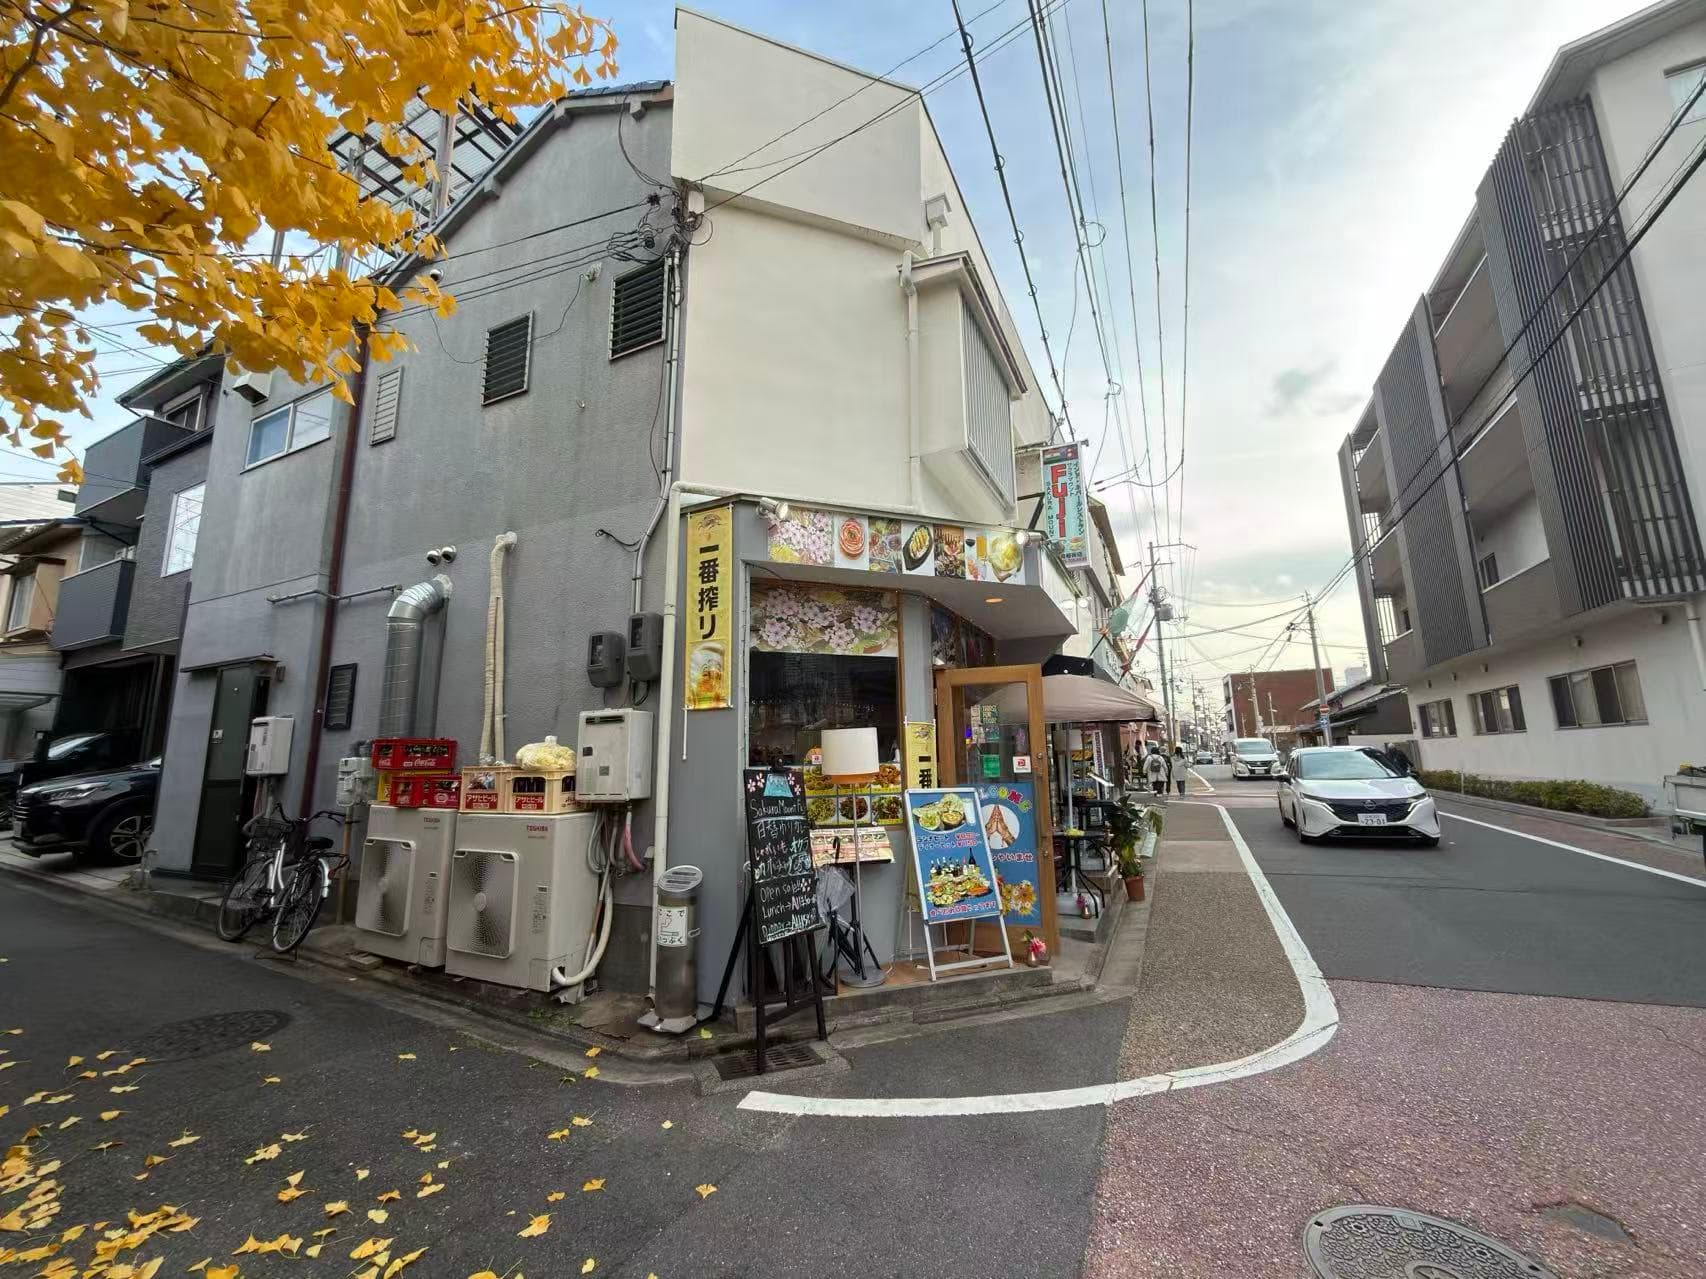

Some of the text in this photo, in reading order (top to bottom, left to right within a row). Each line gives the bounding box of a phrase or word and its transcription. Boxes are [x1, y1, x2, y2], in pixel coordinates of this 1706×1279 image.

[1050, 464, 1068, 538] FUJI
[698, 544, 719, 640] 一番搾り
[466, 794, 497, 803] アサヒビール
[515, 796, 544, 804] アサヒビール
[750, 798, 778, 818] Sakura
